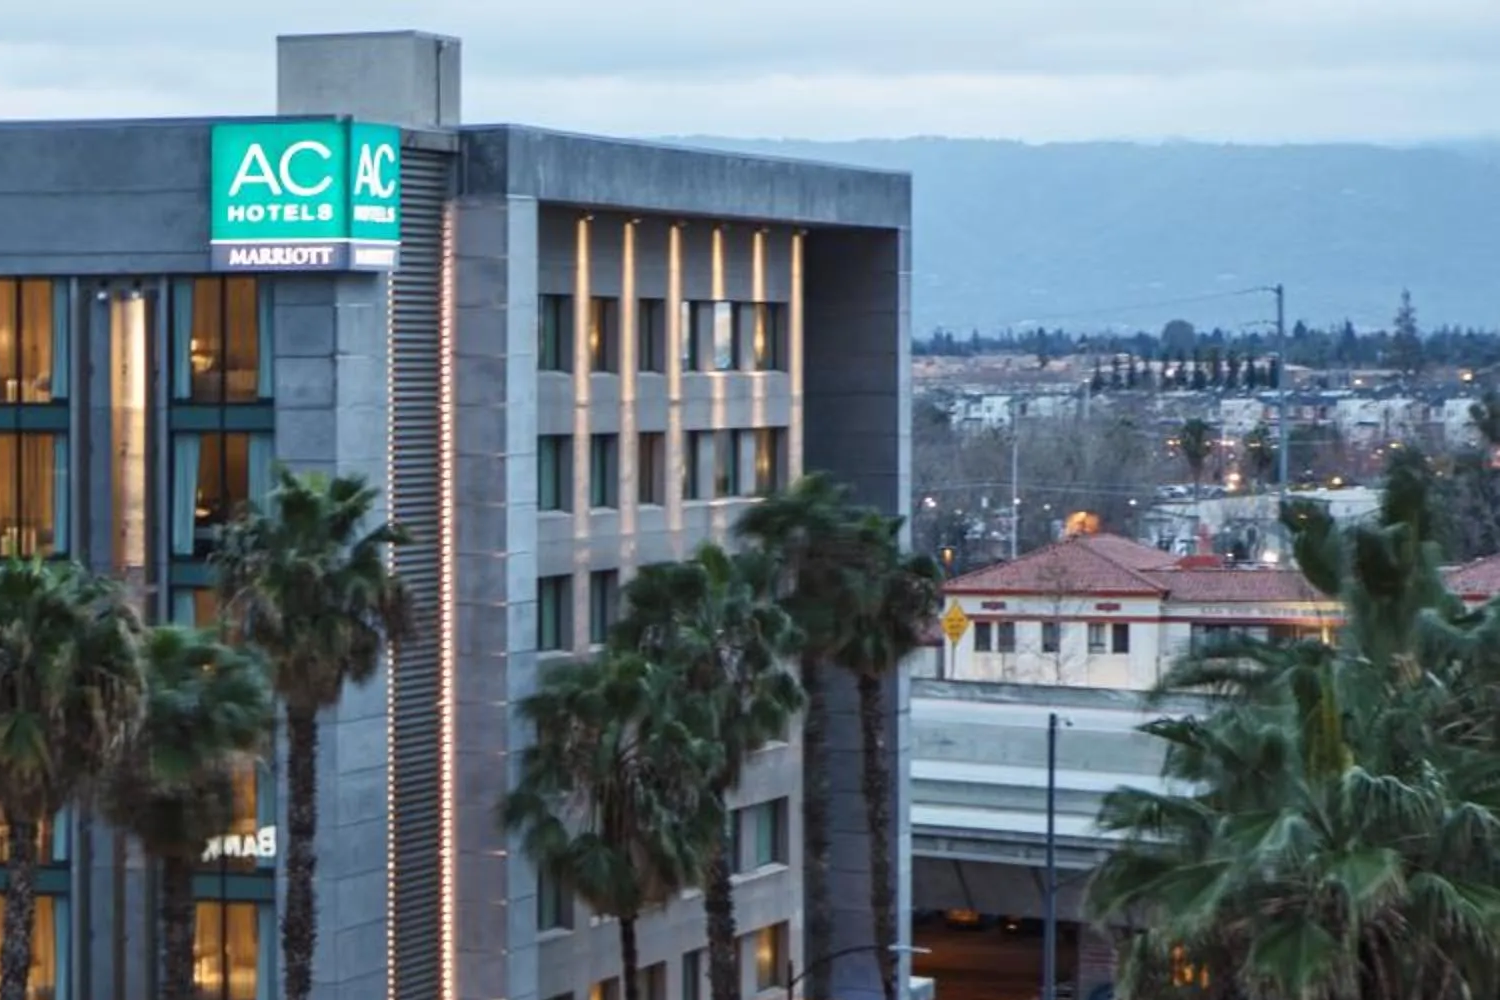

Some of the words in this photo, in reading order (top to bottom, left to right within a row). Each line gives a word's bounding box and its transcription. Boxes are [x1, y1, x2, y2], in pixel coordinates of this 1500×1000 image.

[228, 140, 333, 197] AC
[353, 143, 396, 198] AC
[227, 204, 333, 222] HOTELS
[229, 247, 333, 265] MARRIOTT
